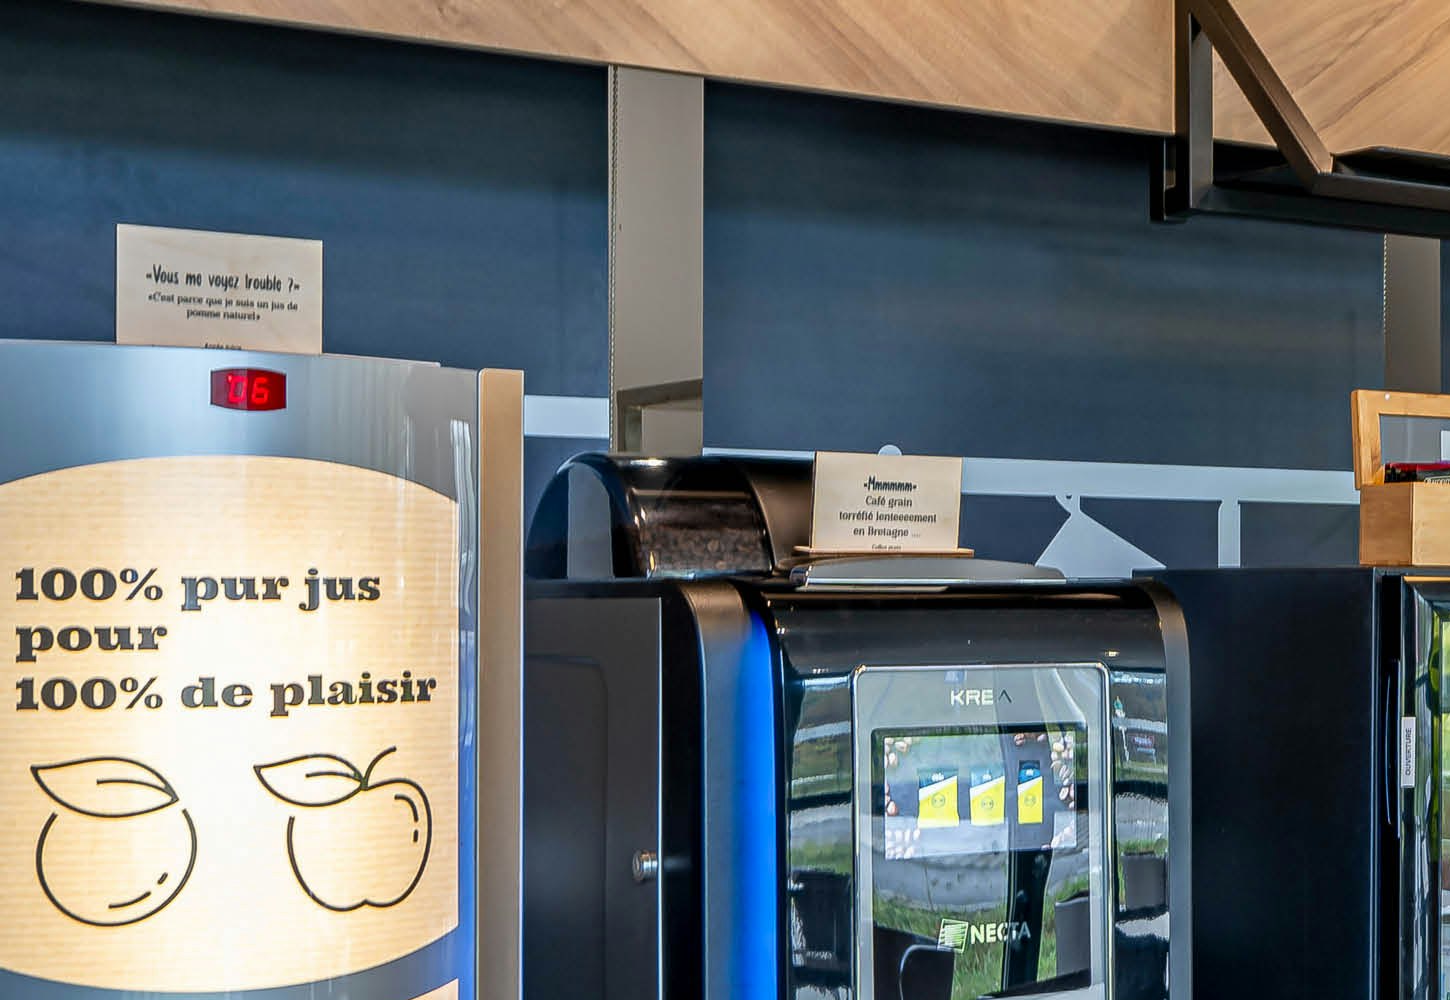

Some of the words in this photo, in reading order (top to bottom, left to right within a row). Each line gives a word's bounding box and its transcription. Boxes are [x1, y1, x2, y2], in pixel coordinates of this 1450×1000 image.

[185, 272, 202, 286] me
[208, 275, 239, 292] voyez
[245, 273, 282, 292] trouble
[177, 296, 203, 305] parce
[205, 298, 223, 307] que
[287, 301, 298, 311] de
[186, 310, 221, 319] pomme
[865, 495, 886, 505] Café
[888, 498, 913, 508] grain
[853, 528, 865, 536] en
[867, 525, 909, 539] Bretagne
[15, 567, 163, 602] 100%
[180, 575, 289, 612] pur
[298, 568, 382, 612] jus
[15, 624, 167, 663] pour
[15, 676, 164, 711] 100%
[180, 676, 253, 709] de
[270, 671, 438, 718] plaisir
[970, 921, 1031, 944] NECTA
